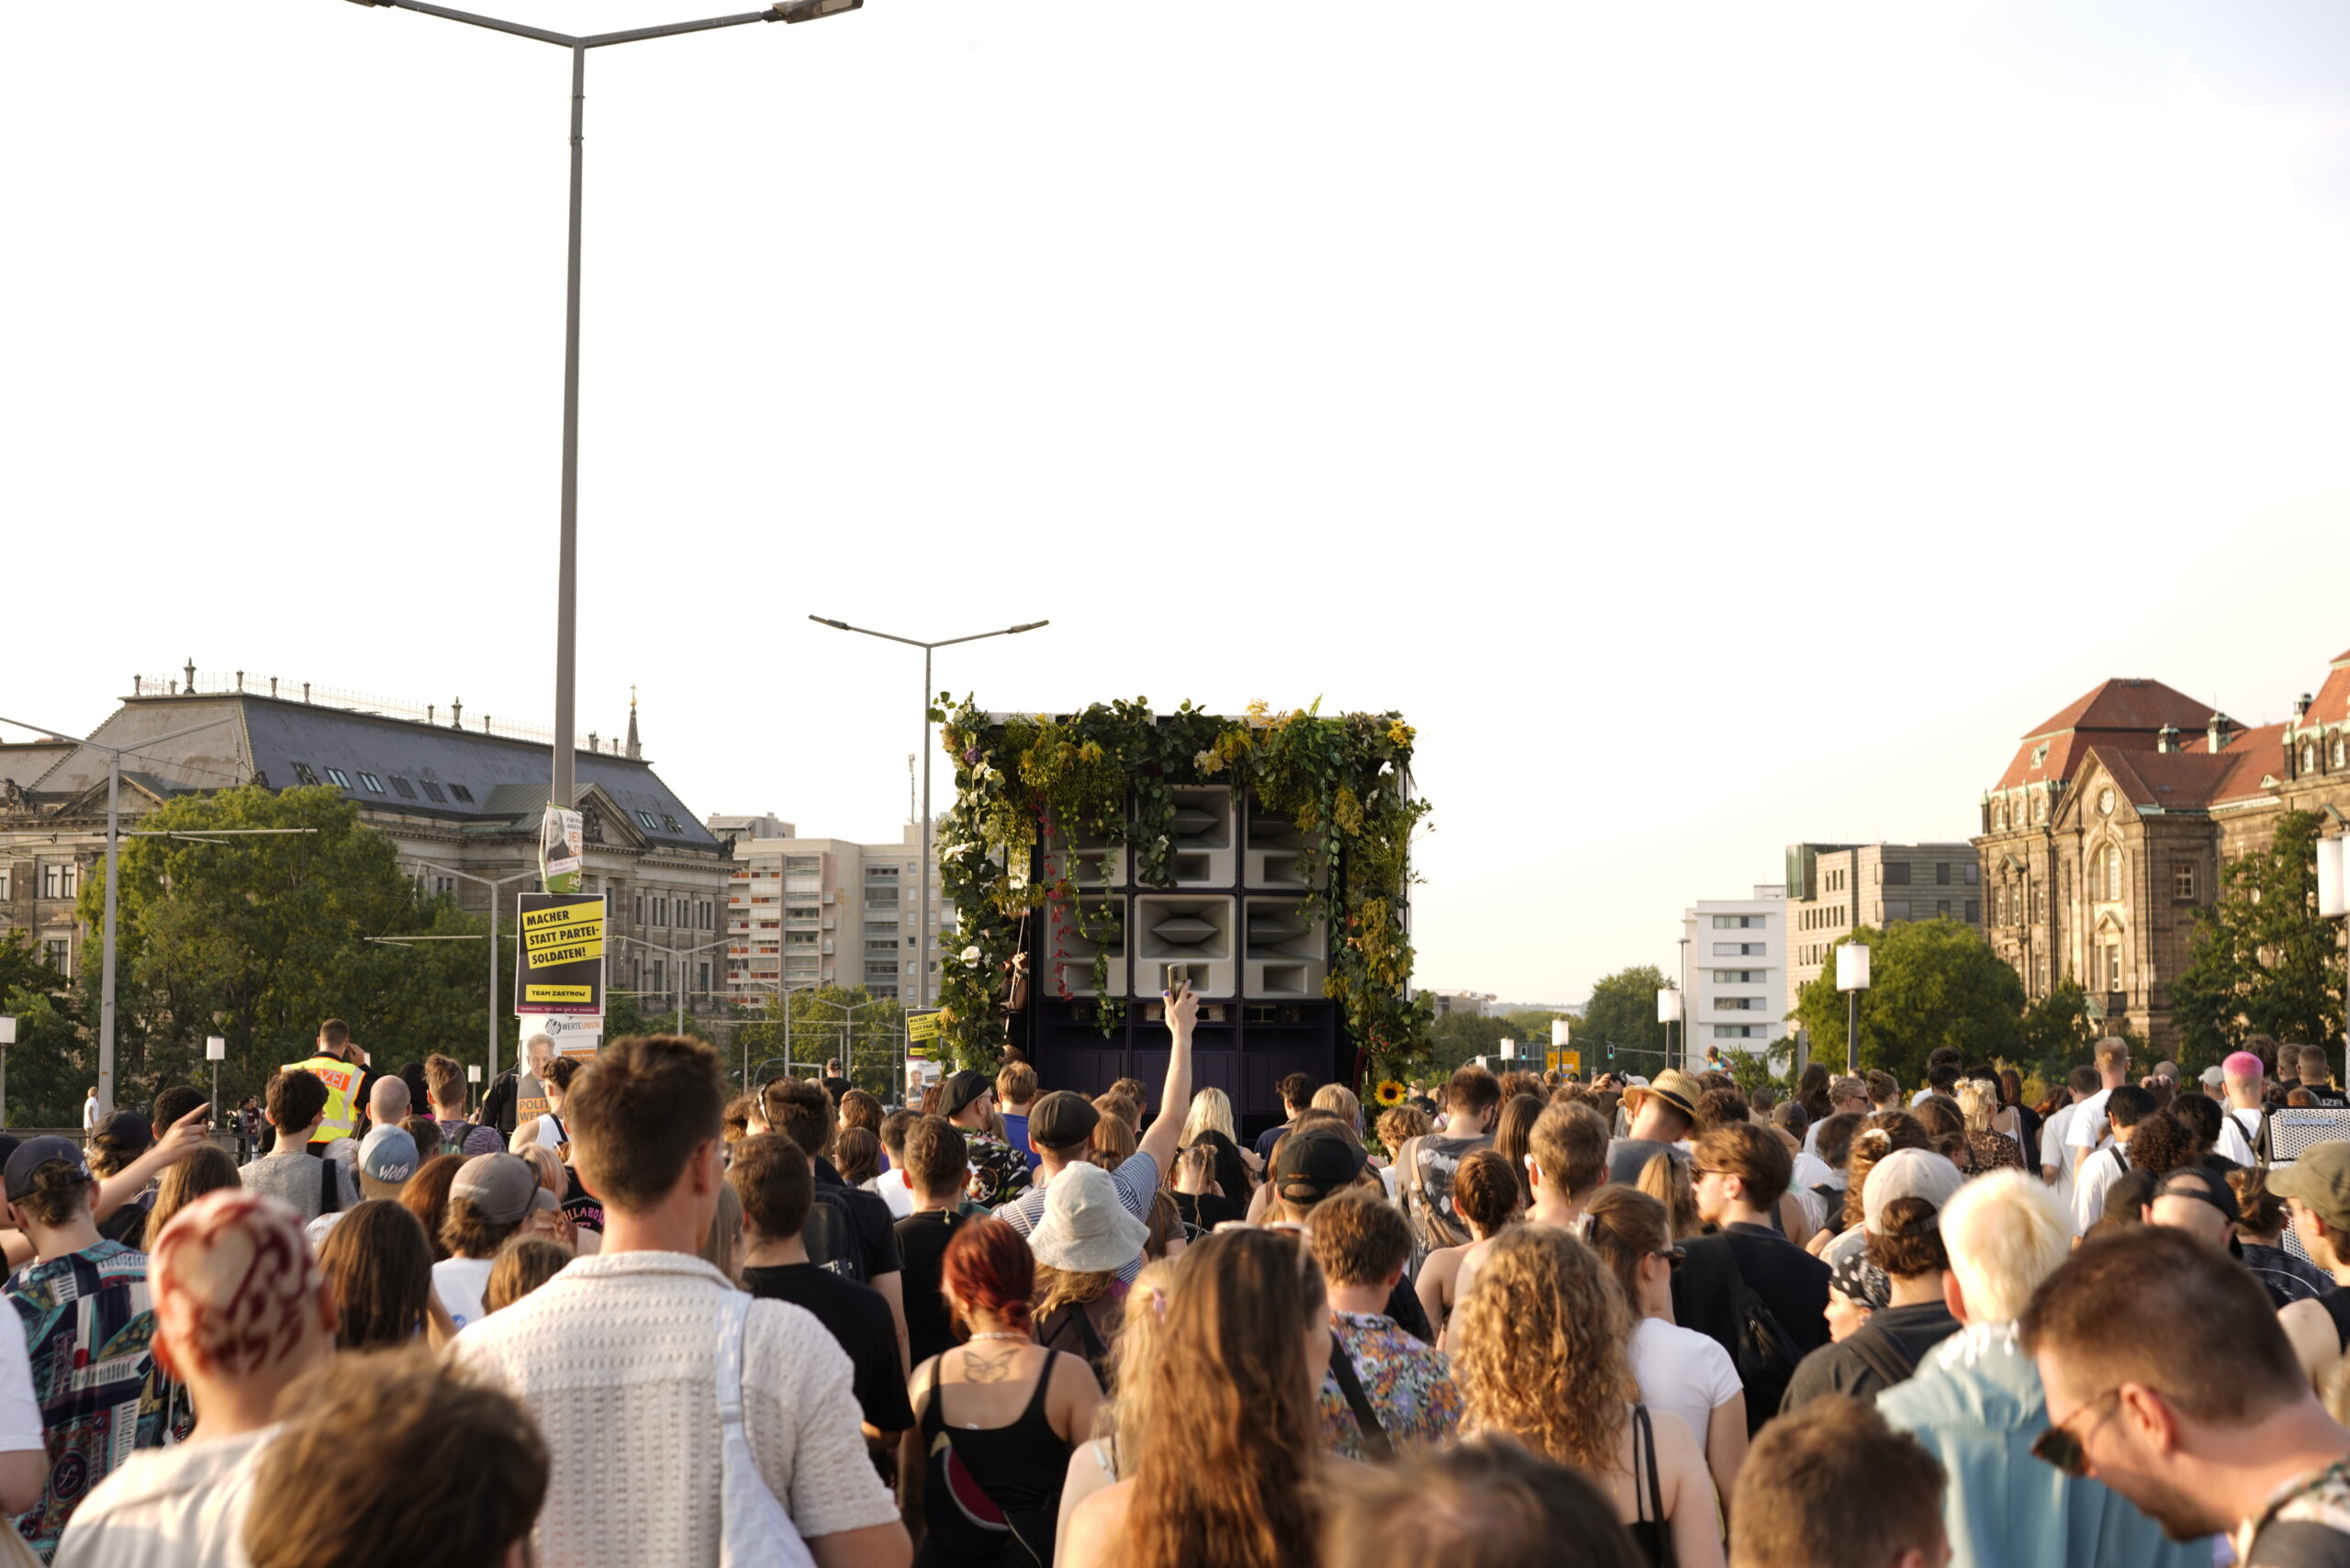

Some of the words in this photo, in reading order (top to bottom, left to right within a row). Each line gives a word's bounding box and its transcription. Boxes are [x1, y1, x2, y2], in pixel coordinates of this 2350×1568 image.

[527, 911, 570, 926] MACHER
[530, 932, 556, 946] STATT
[560, 925, 599, 940] PARTEI-
[532, 946, 587, 965] SOLDATEN!
[561, 1021, 600, 1031] WERTEUNION
[319, 1069, 346, 1090] IZEI
[520, 1099, 550, 1110] POLIT
[2321, 1098, 2344, 1107] IZEI
[520, 1111, 551, 1122] WEN
